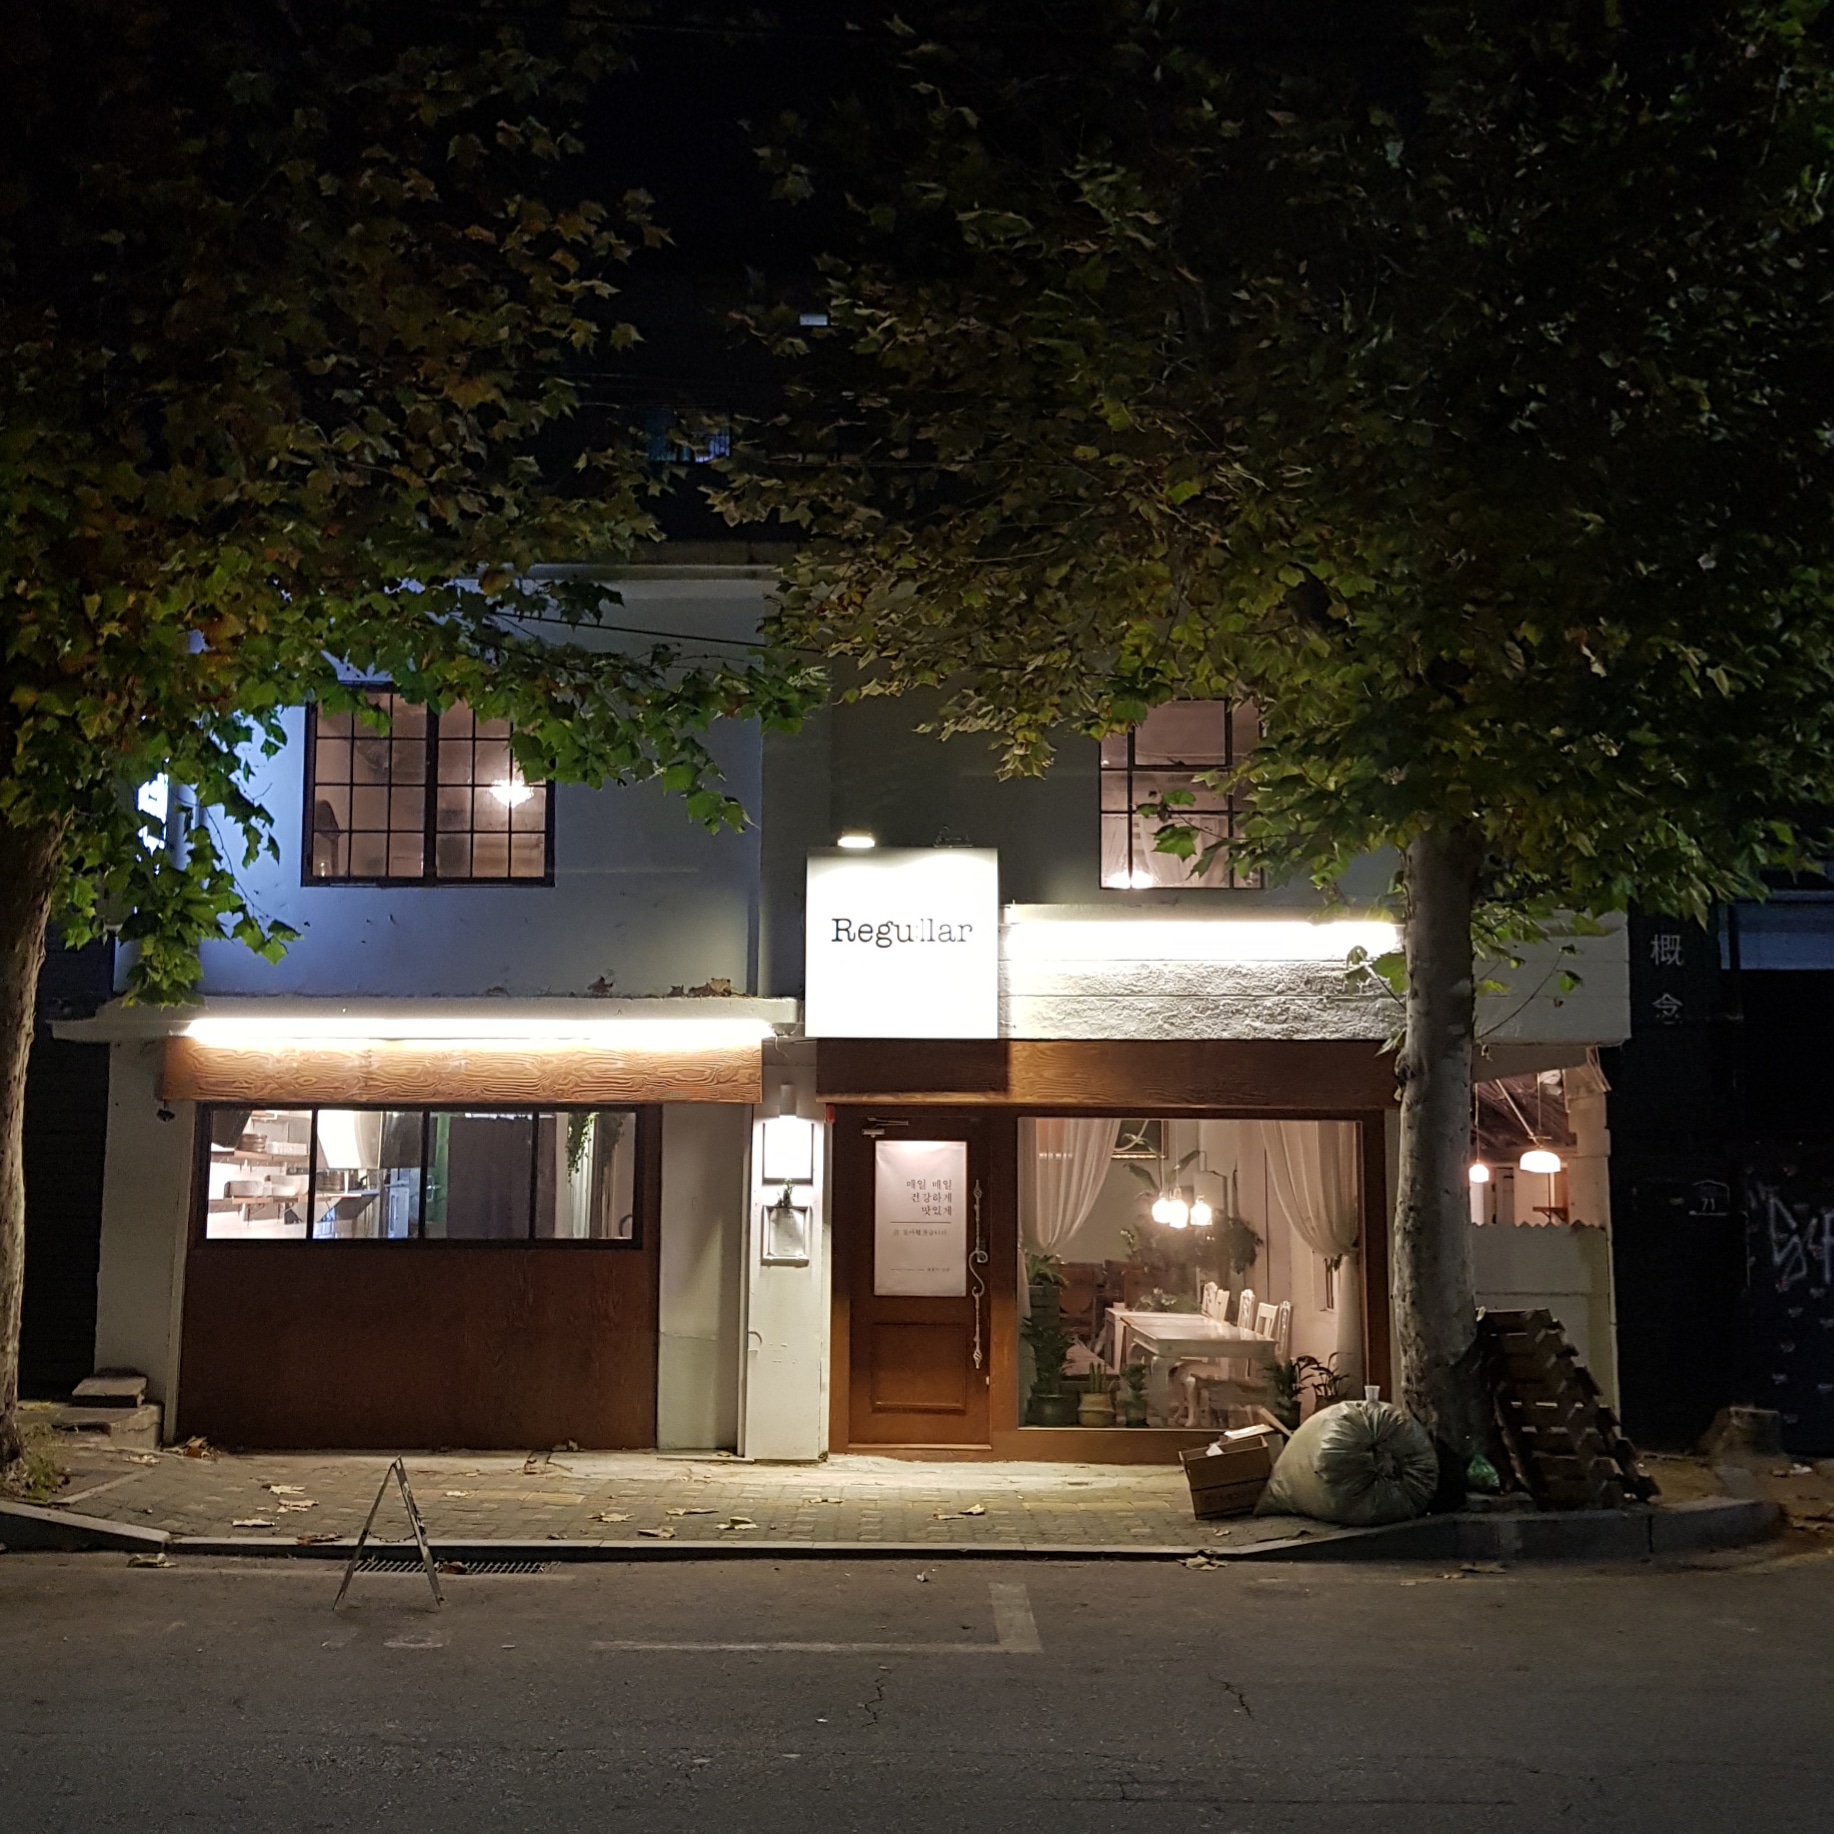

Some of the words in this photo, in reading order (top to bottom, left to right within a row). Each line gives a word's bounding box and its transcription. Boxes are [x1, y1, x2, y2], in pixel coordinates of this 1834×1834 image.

[906, 1179, 926, 1190] 매일
[932, 1179, 952, 1190] 매일
[911, 1192, 952, 1203] 건강하게
[921, 1205, 952, 1216] 맛있게
